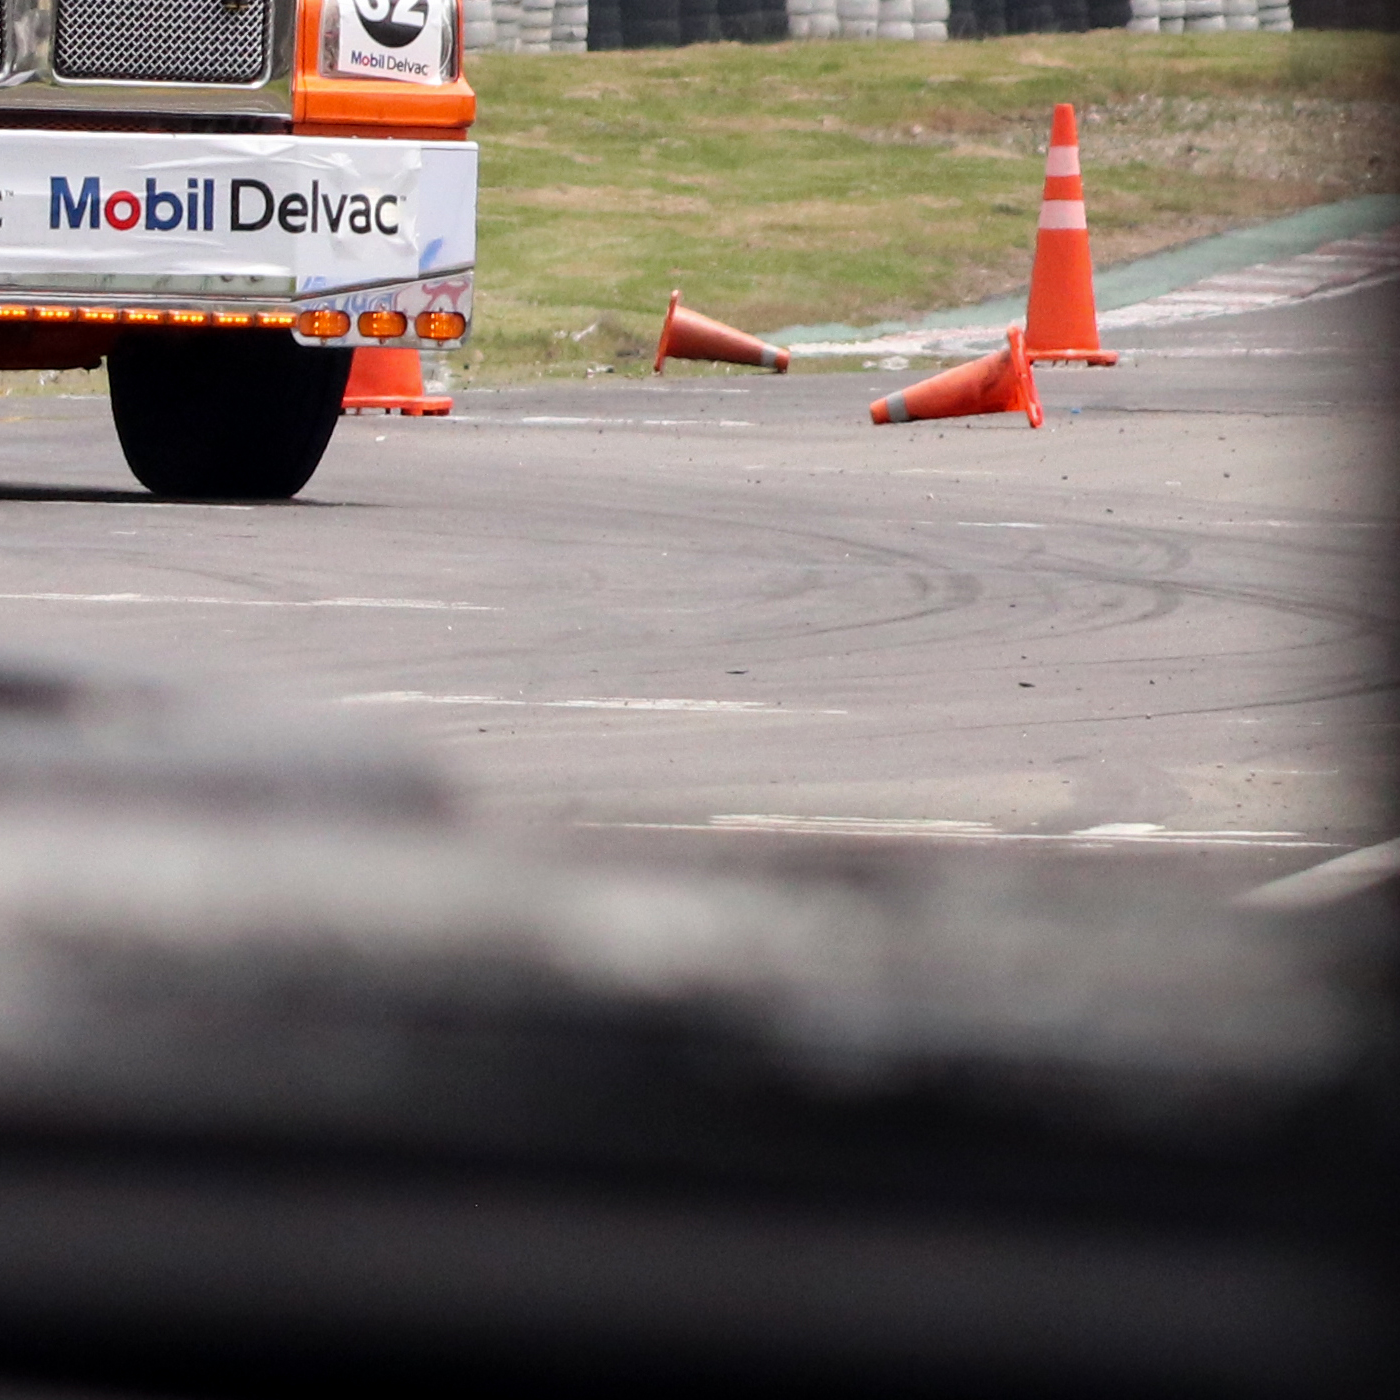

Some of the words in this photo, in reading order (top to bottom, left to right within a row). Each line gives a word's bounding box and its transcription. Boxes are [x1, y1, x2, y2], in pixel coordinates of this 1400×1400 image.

[350, 50, 385, 69] Mobil
[386, 56, 429, 76] Delvac
[49, 175, 215, 233] Mobil
